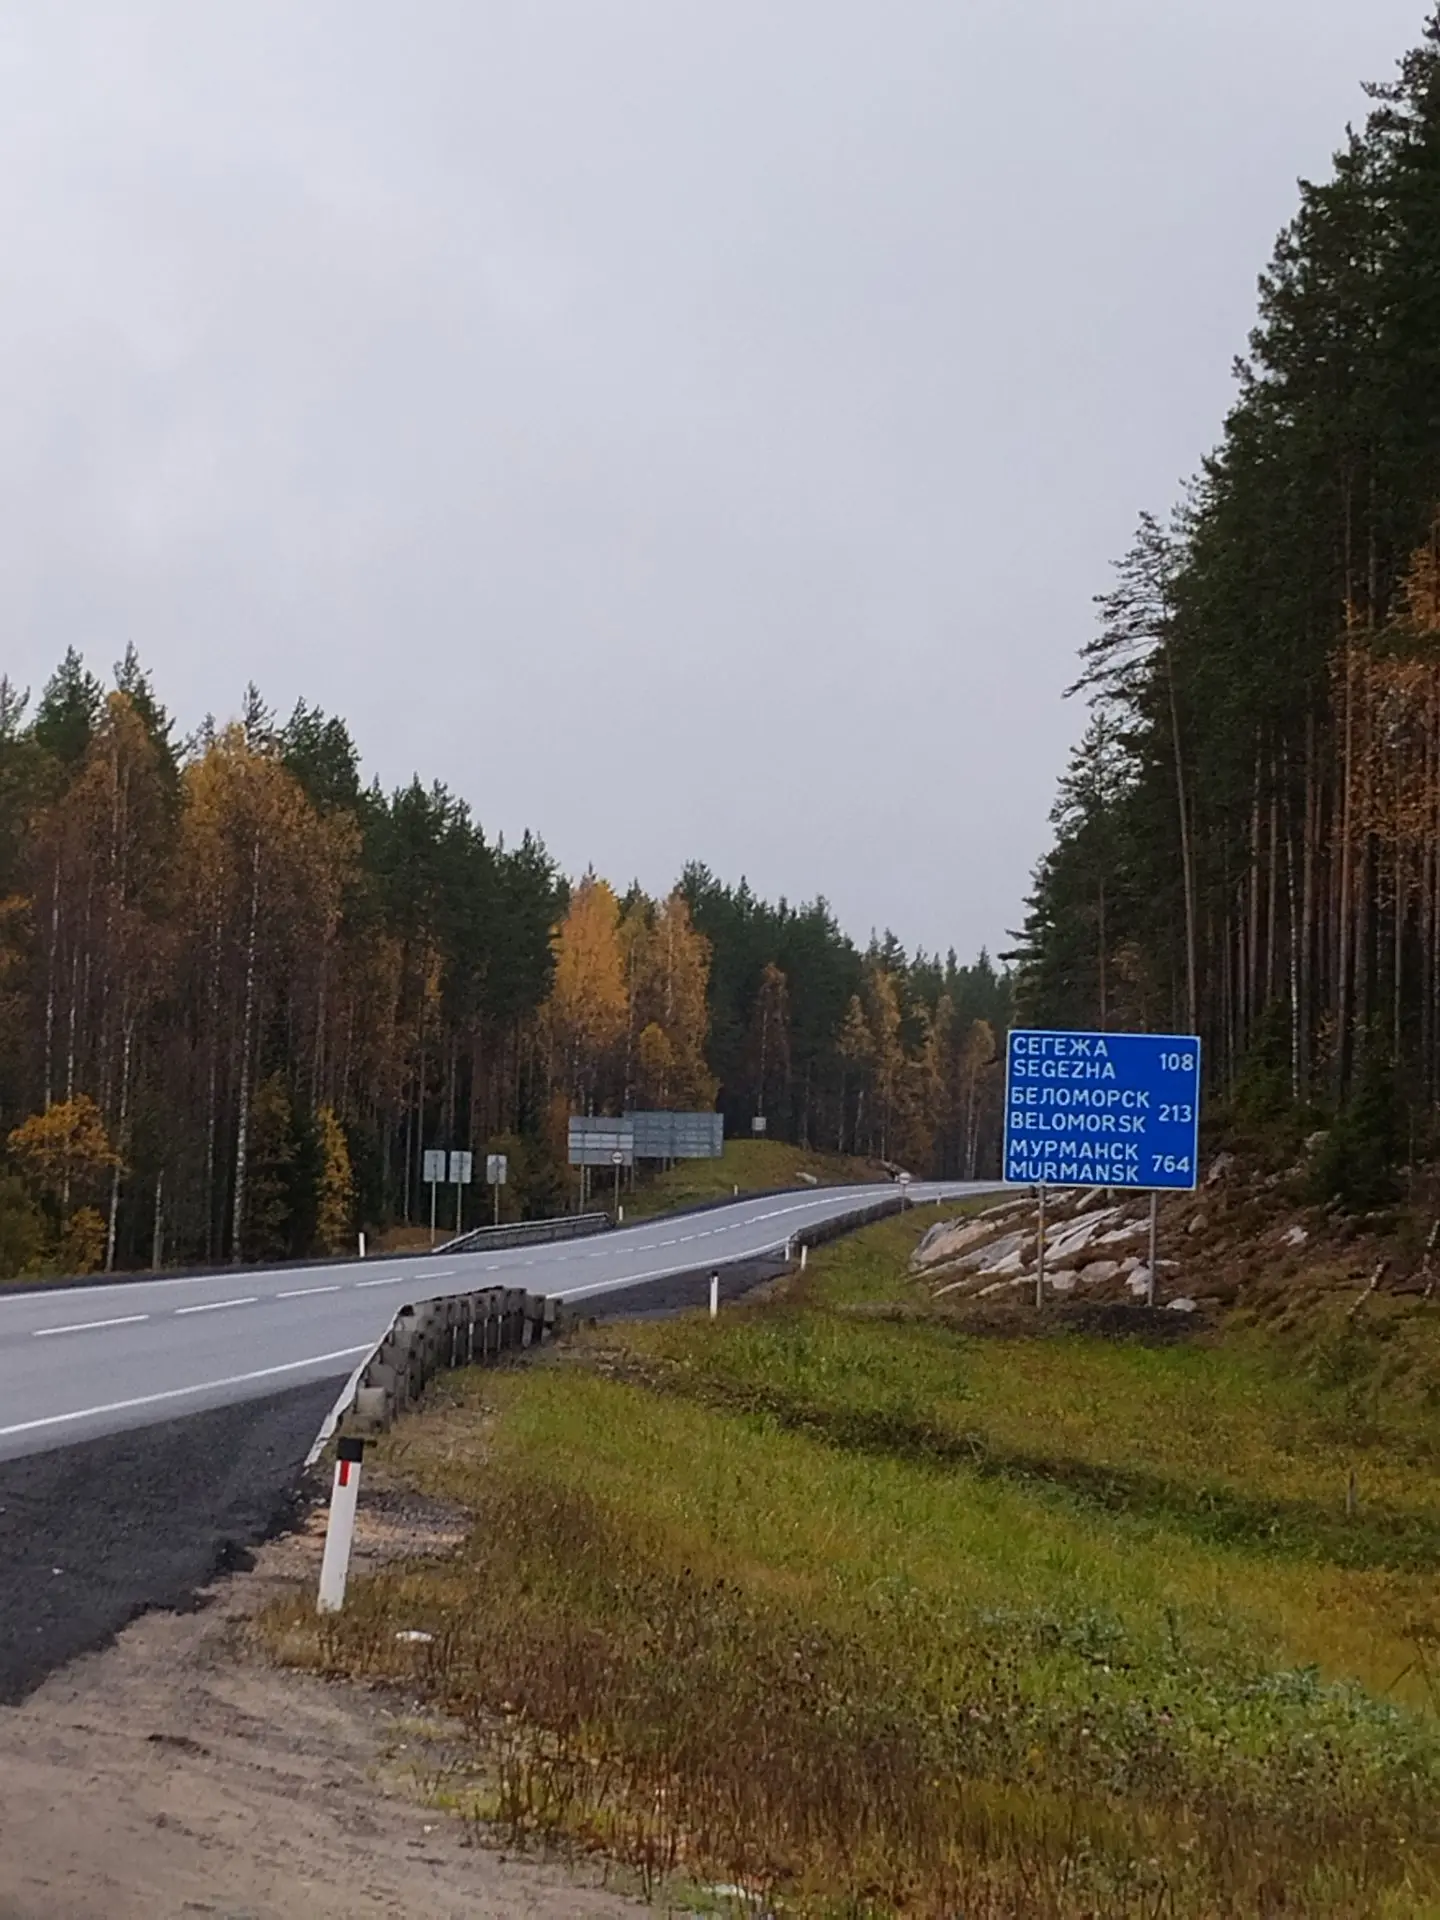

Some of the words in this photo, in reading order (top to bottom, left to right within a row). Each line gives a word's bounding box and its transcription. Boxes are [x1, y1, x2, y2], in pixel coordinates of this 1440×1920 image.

[1013, 1037, 1108, 1057] СЕГЕЖА
[1013, 1059, 1116, 1079] SEGEZHA
[1159, 1053, 1194, 1071] 108
[1011, 1086, 1150, 1108] БЕЛОМОРСК
[1010, 1111, 1146, 1133] BELOMORSK
[1158, 1104, 1191, 1122] 213
[1009, 1139, 1139, 1161] МУРМАНСК
[1008, 1160, 1139, 1182] MURMANSK
[1151, 1155, 1190, 1173] 764
